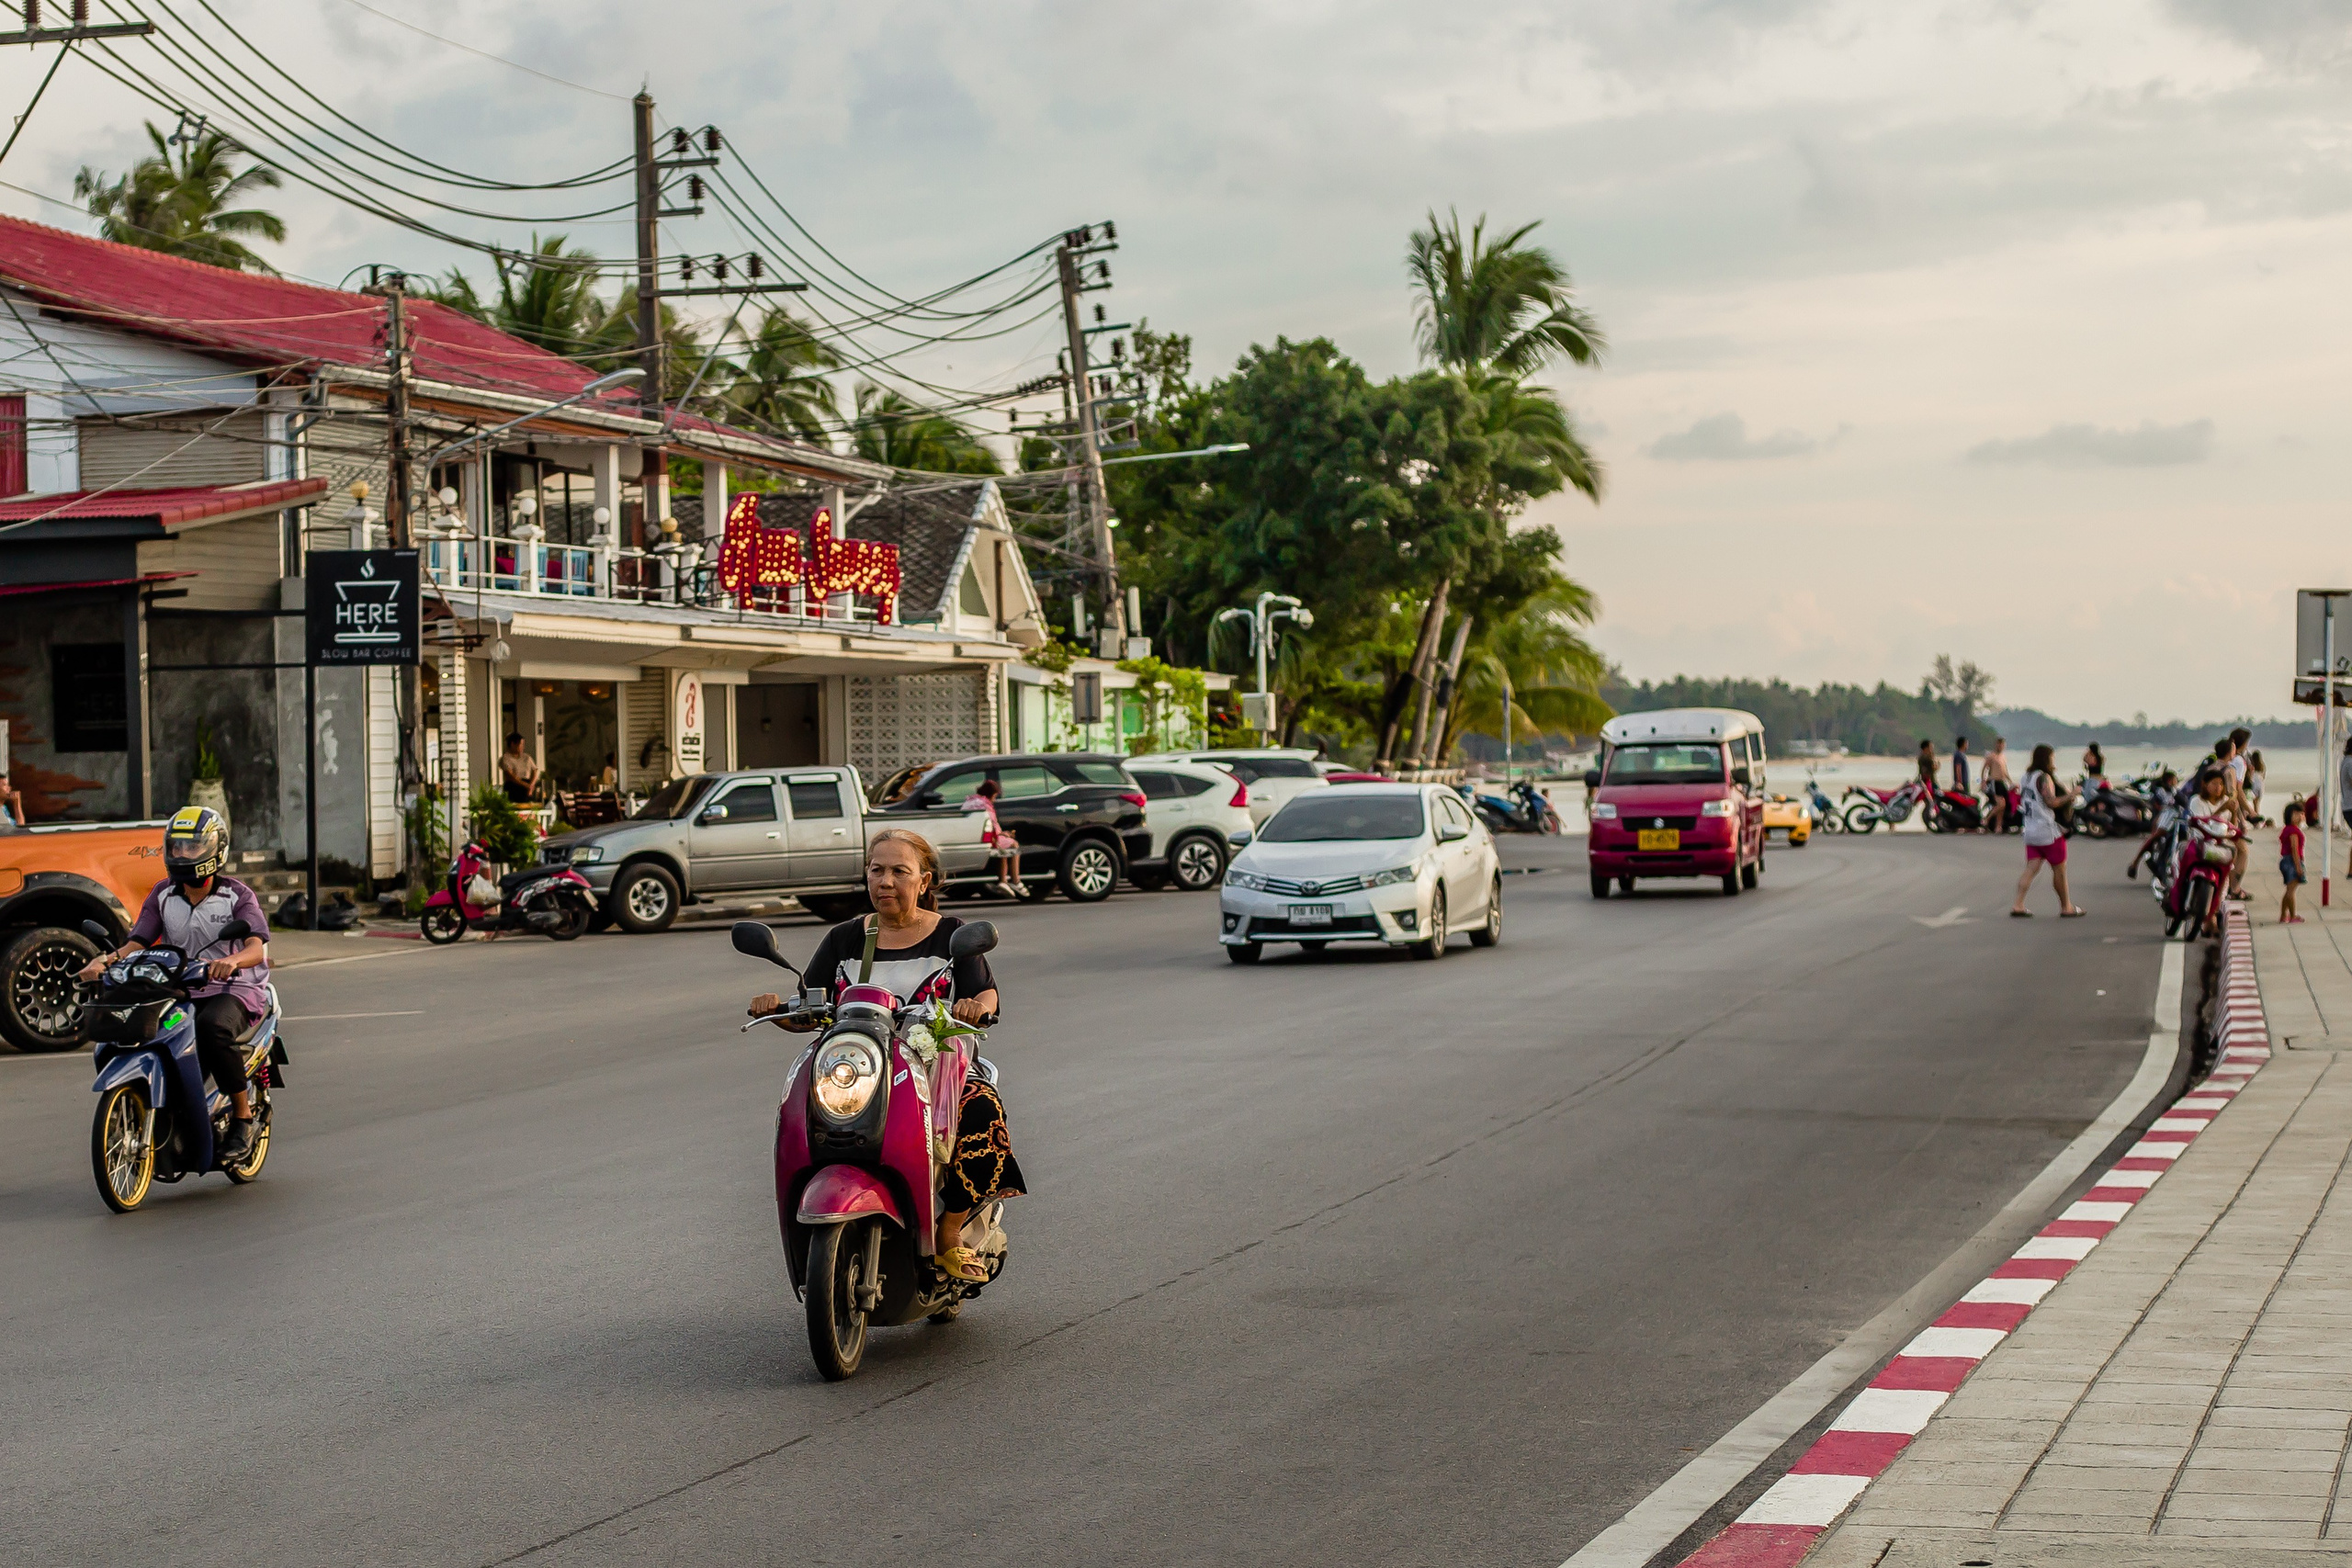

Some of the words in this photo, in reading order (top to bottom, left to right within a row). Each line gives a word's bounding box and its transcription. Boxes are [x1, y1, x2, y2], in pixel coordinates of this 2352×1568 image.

[335, 603, 399, 625] HERE
[321, 649, 349, 659] SLOW
[352, 649, 371, 659] BAR
[374, 648, 412, 659] COFFEE
